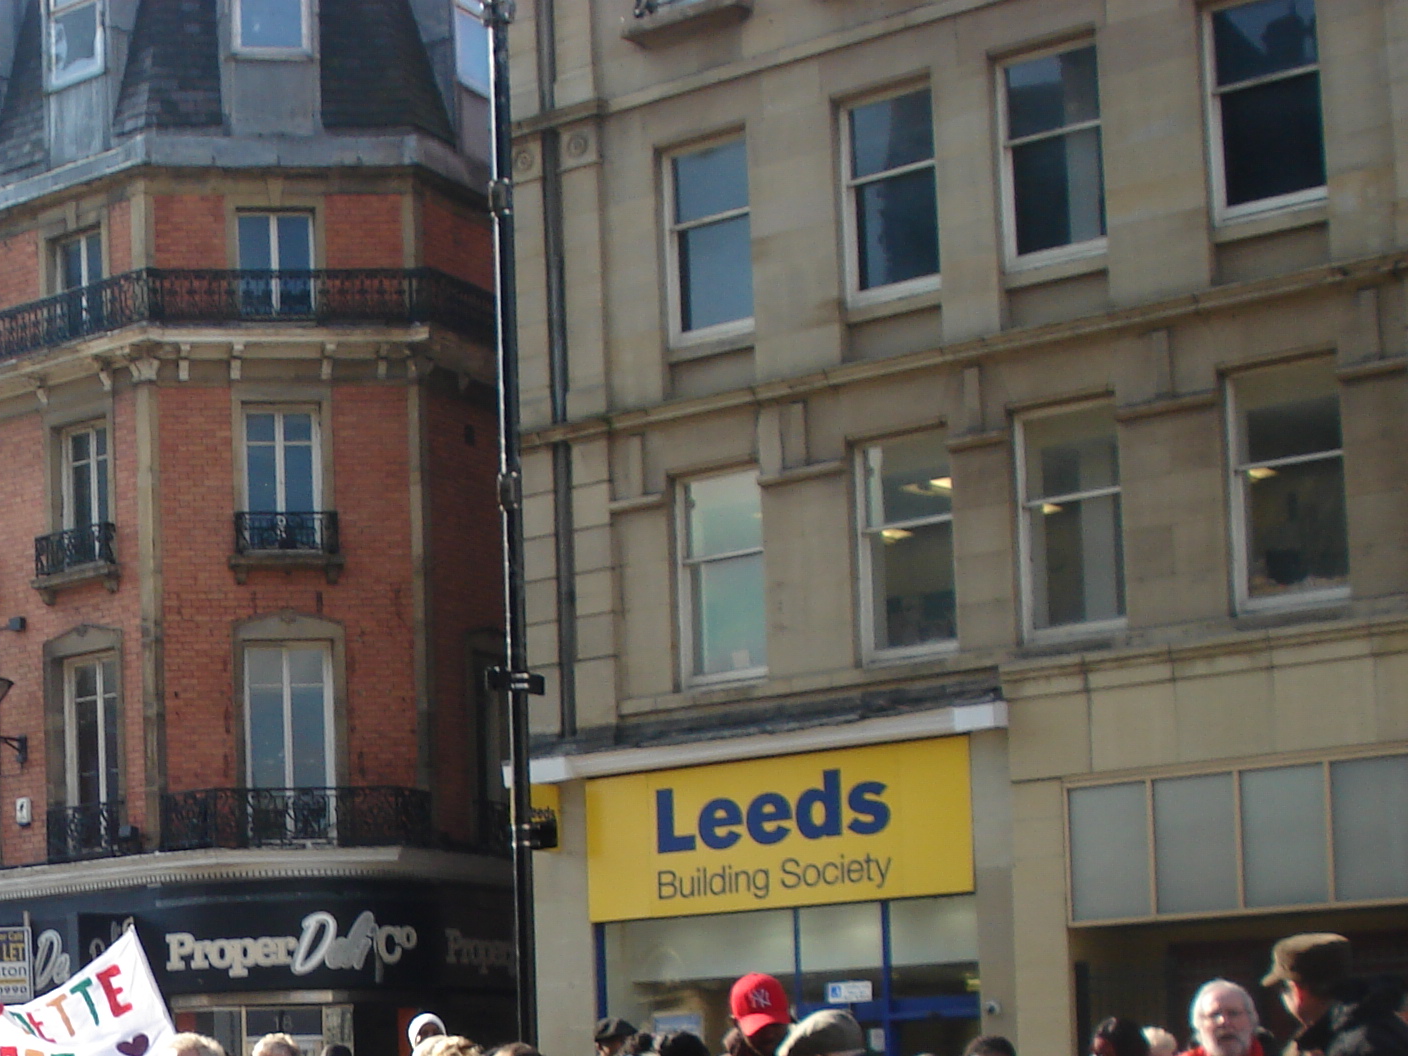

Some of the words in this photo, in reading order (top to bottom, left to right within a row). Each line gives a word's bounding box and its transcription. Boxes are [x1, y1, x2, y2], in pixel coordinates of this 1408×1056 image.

[656, 768, 891, 854] Leeds
[657, 864, 770, 900] Building
[780, 852, 891, 889] Society
[2, 942, 25, 962] LET
[165, 931, 298, 978] Proper
[377, 924, 418, 965] Co
